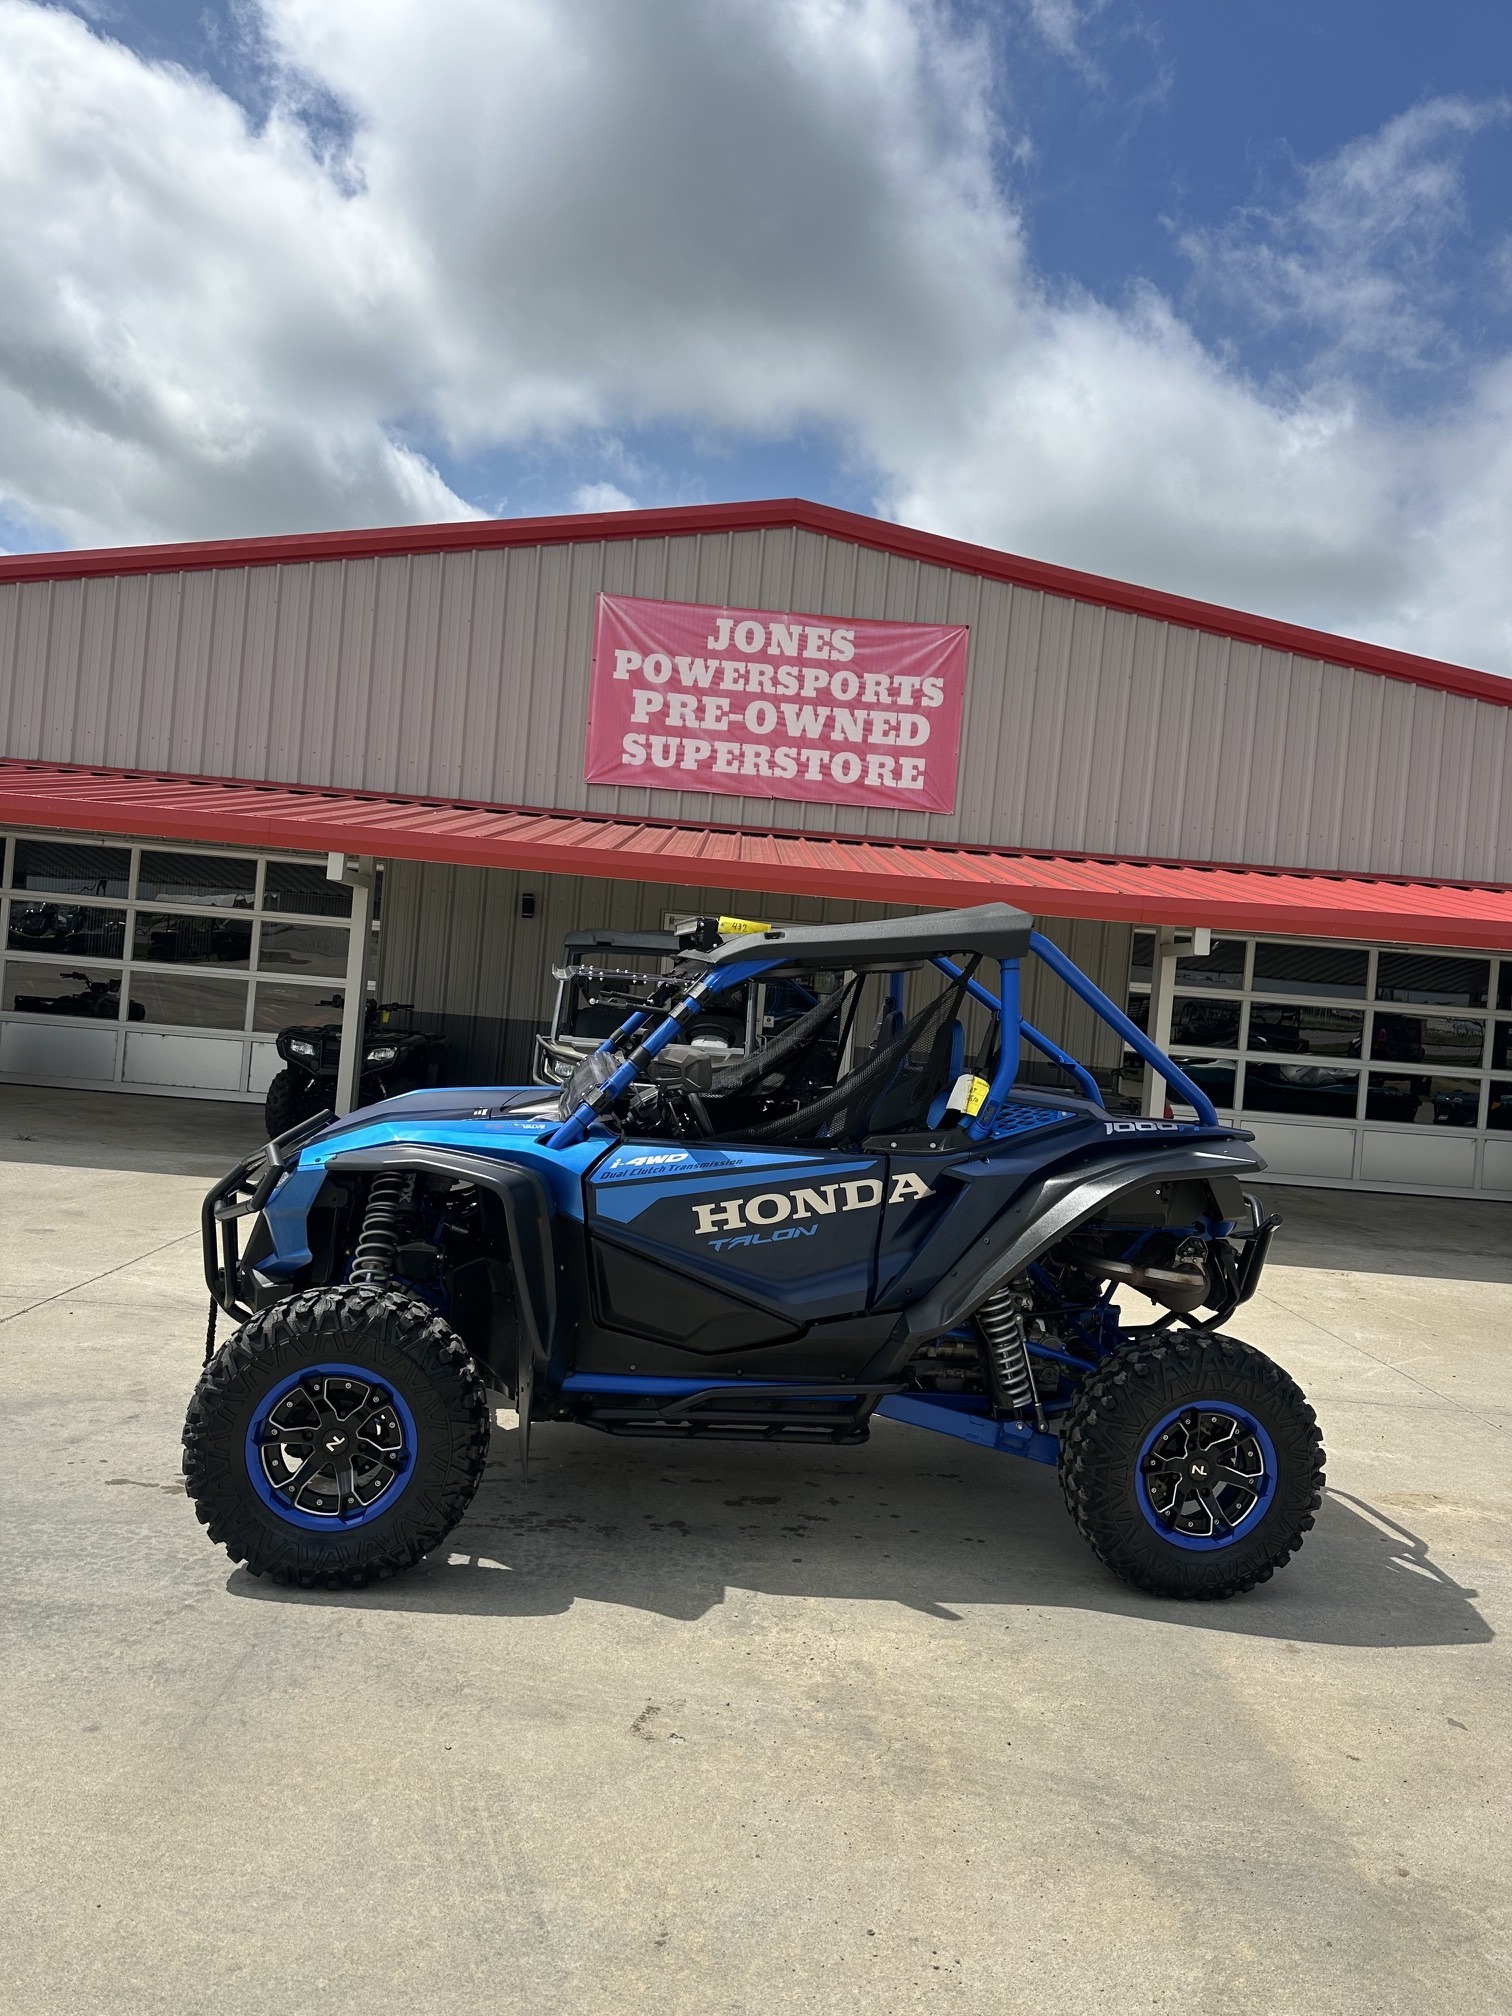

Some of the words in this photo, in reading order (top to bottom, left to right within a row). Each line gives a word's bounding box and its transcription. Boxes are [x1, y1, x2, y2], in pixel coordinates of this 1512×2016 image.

[707, 618, 855, 662] JONES
[613, 649, 944, 708] POWERSPORTS
[630, 688, 931, 747] PRE-OWNED
[621, 732, 926, 790] SUPERSTORE
[600, 1170, 628, 1180] Dual
[629, 1166, 665, 1177] Clutch
[669, 1158, 743, 1172] Transmission
[609, 1153, 689, 1169] i-4WD
[691, 1172, 936, 1235] HONDA
[707, 1223, 819, 1252] TALON
